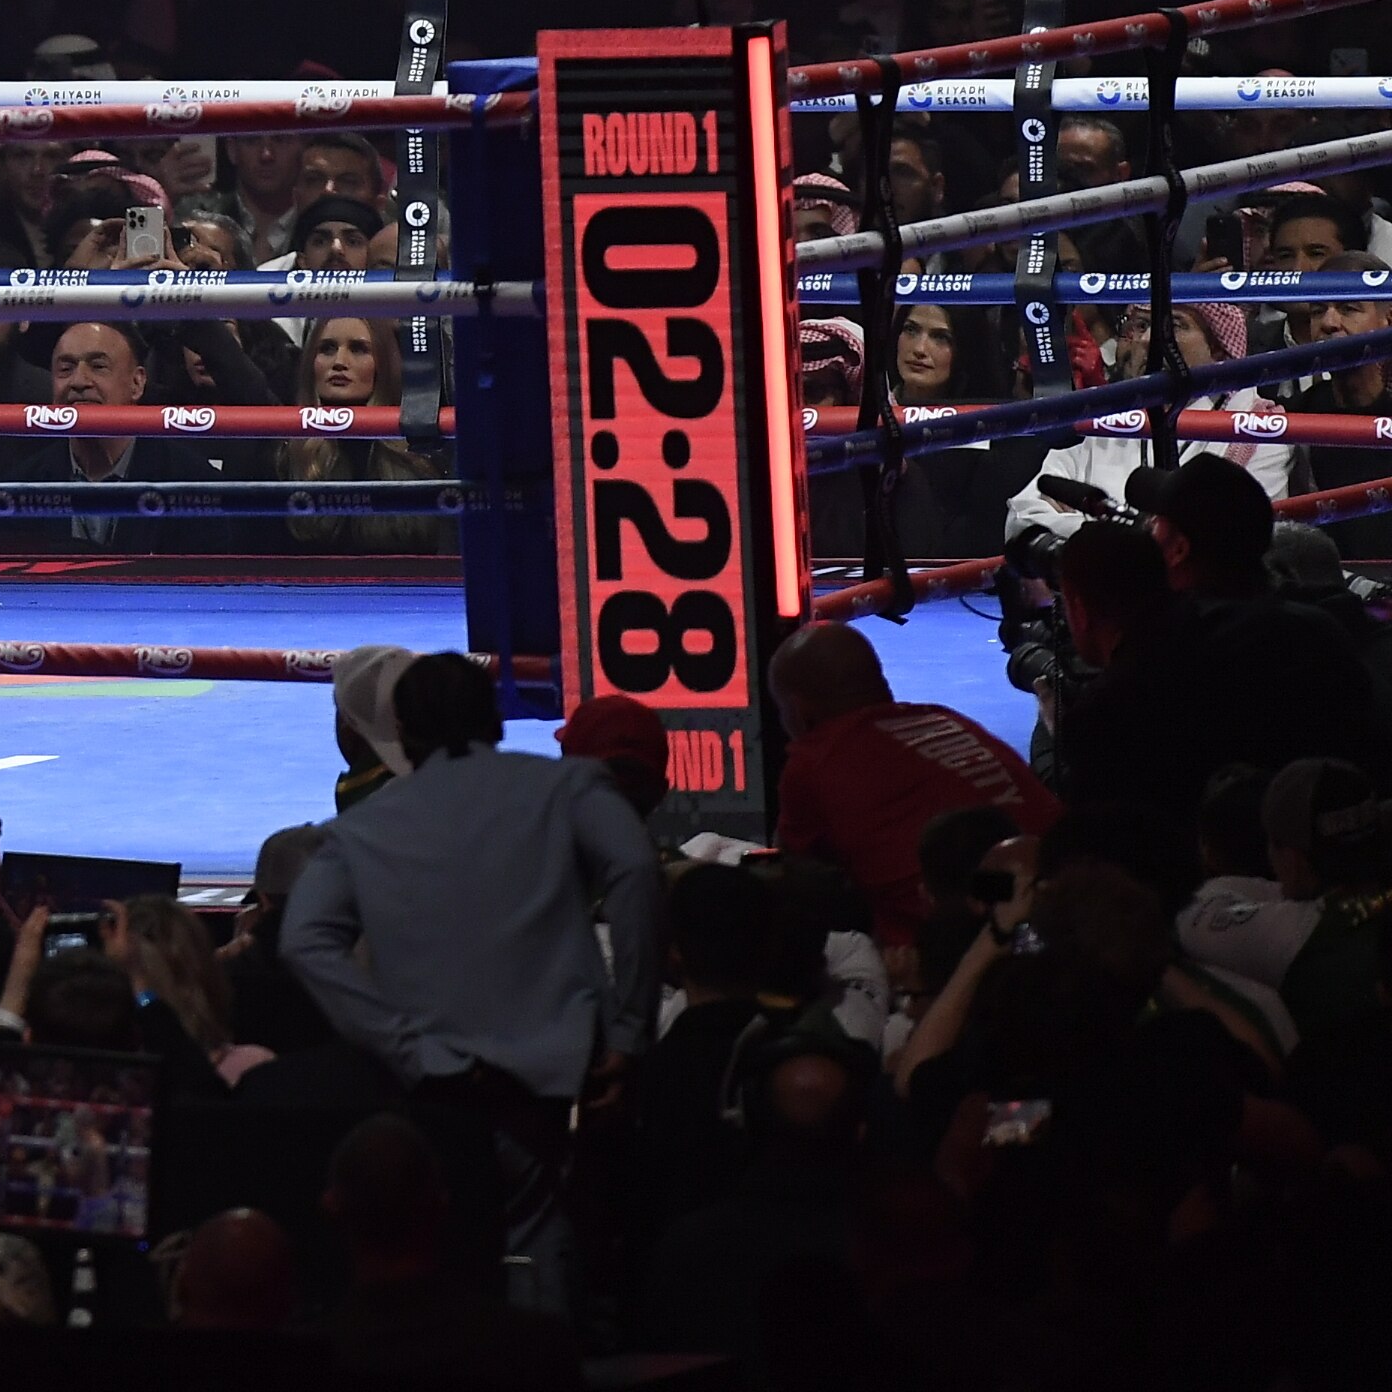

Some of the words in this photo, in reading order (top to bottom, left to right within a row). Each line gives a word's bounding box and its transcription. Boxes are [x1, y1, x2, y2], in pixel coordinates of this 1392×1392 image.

[54, 91, 101, 99] RIYADH
[192, 90, 239, 98] RIYADH
[330, 89, 378, 98] RIYADH
[582, 111, 698, 176] ROUND
[701, 110, 718, 173] 1
[40, 270, 89, 278] RIYADH
[178, 270, 227, 278] RIYADH
[796, 281, 831, 291] ASON
[921, 283, 971, 291] SEASON
[1108, 279, 1150, 289] SEASO
[24, 406, 78, 430] RING
[161, 407, 215, 431] RING
[299, 408, 354, 431] RING
[1230, 412, 1287, 437] RING
[581, 205, 737, 693] 02:28
[728, 730, 745, 791] 1
